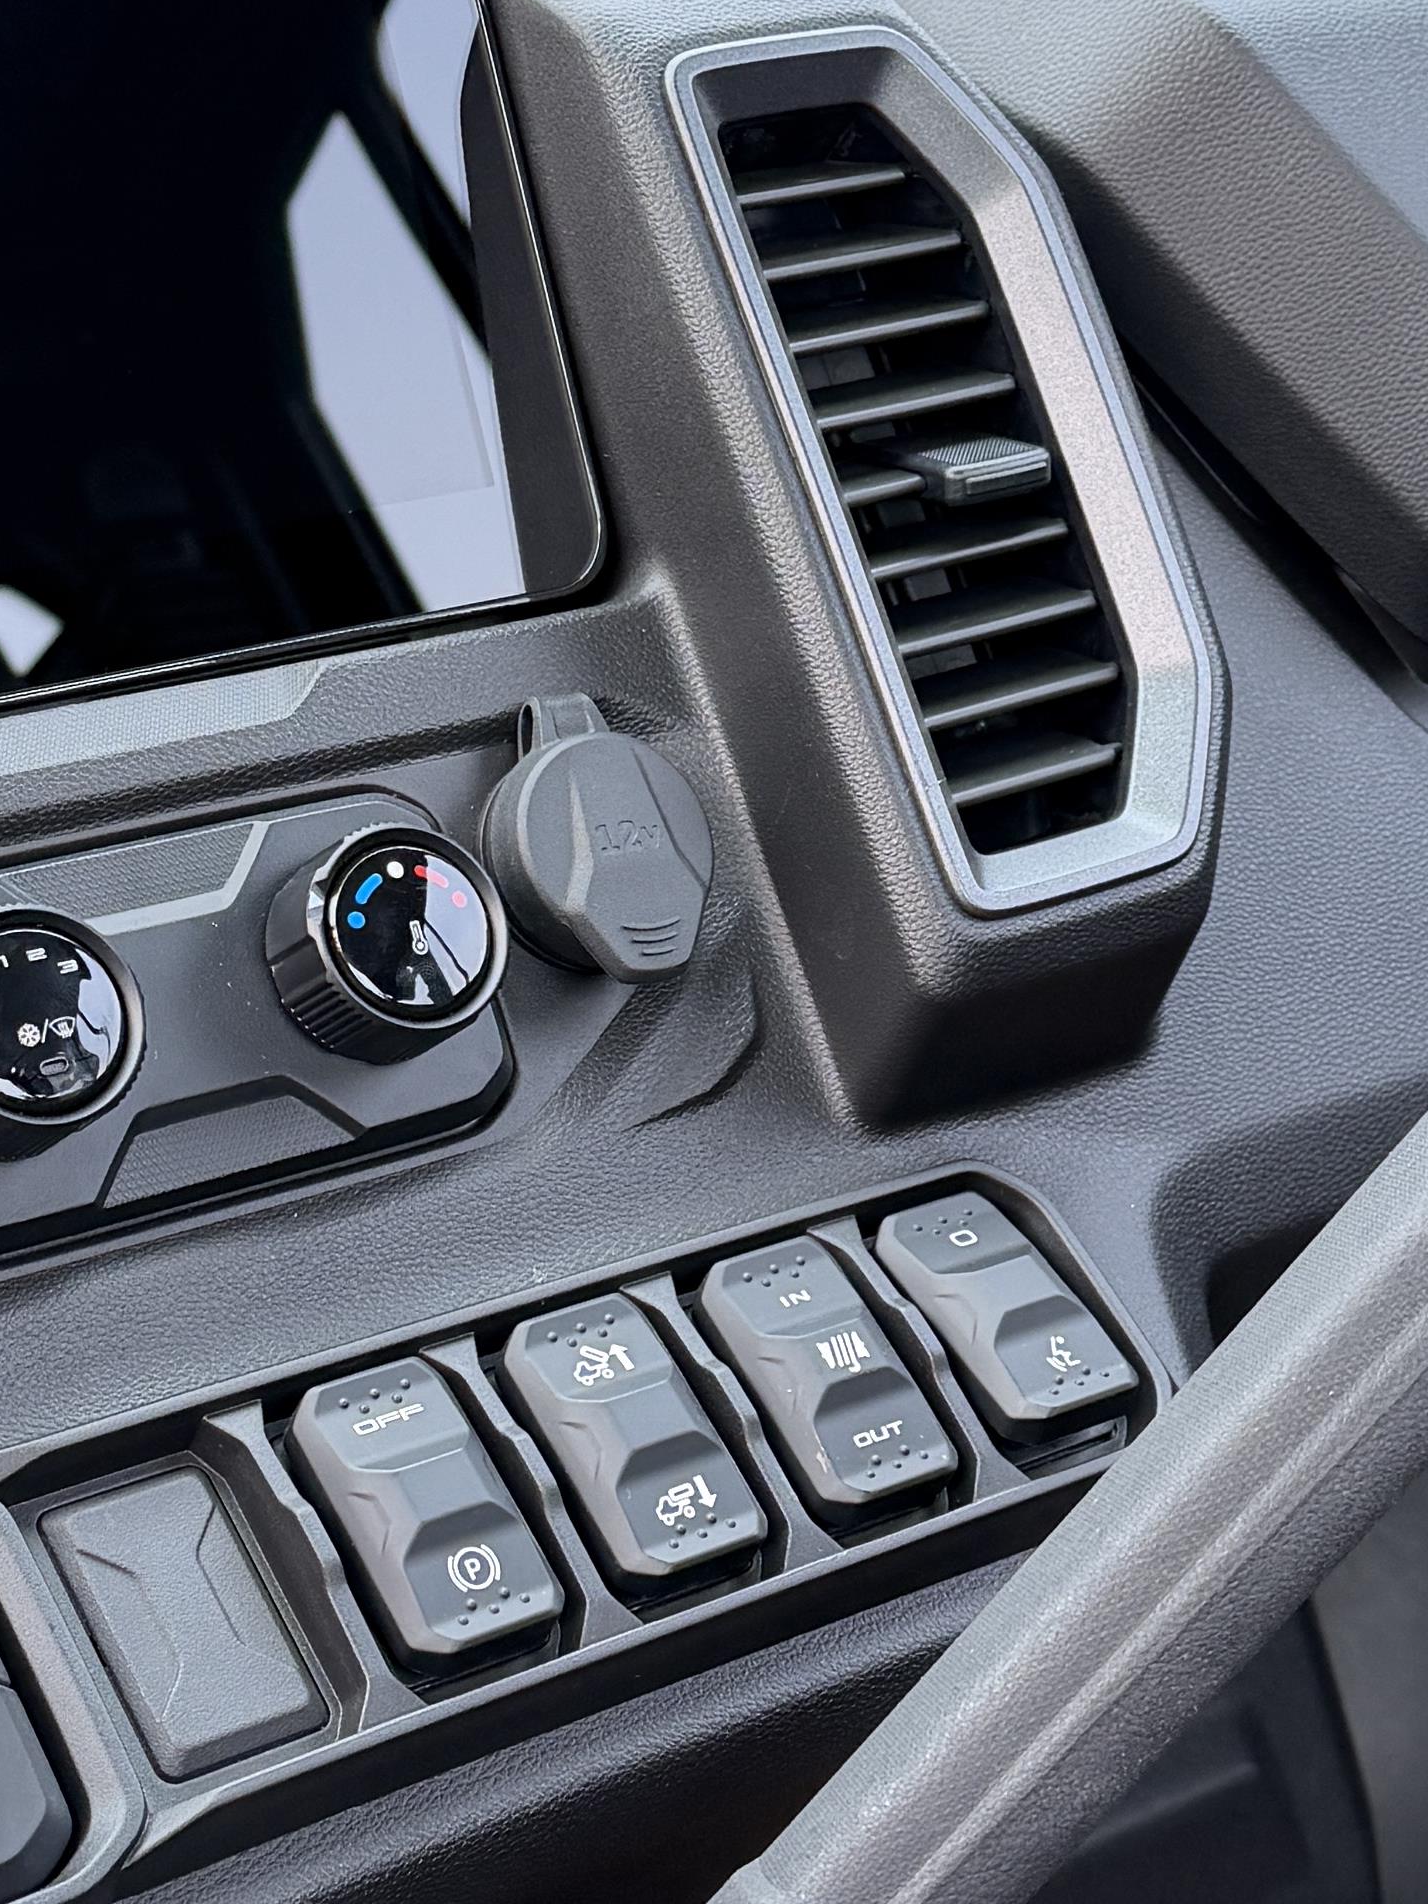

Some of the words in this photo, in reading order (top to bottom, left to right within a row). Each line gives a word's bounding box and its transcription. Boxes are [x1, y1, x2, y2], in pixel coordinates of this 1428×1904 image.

[25, 947, 47, 962] 2
[57, 959, 79, 974] 3
[779, 1289, 812, 1308] IN
[352, 1403, 425, 1436] OFF
[853, 1420, 903, 1448] OUT
